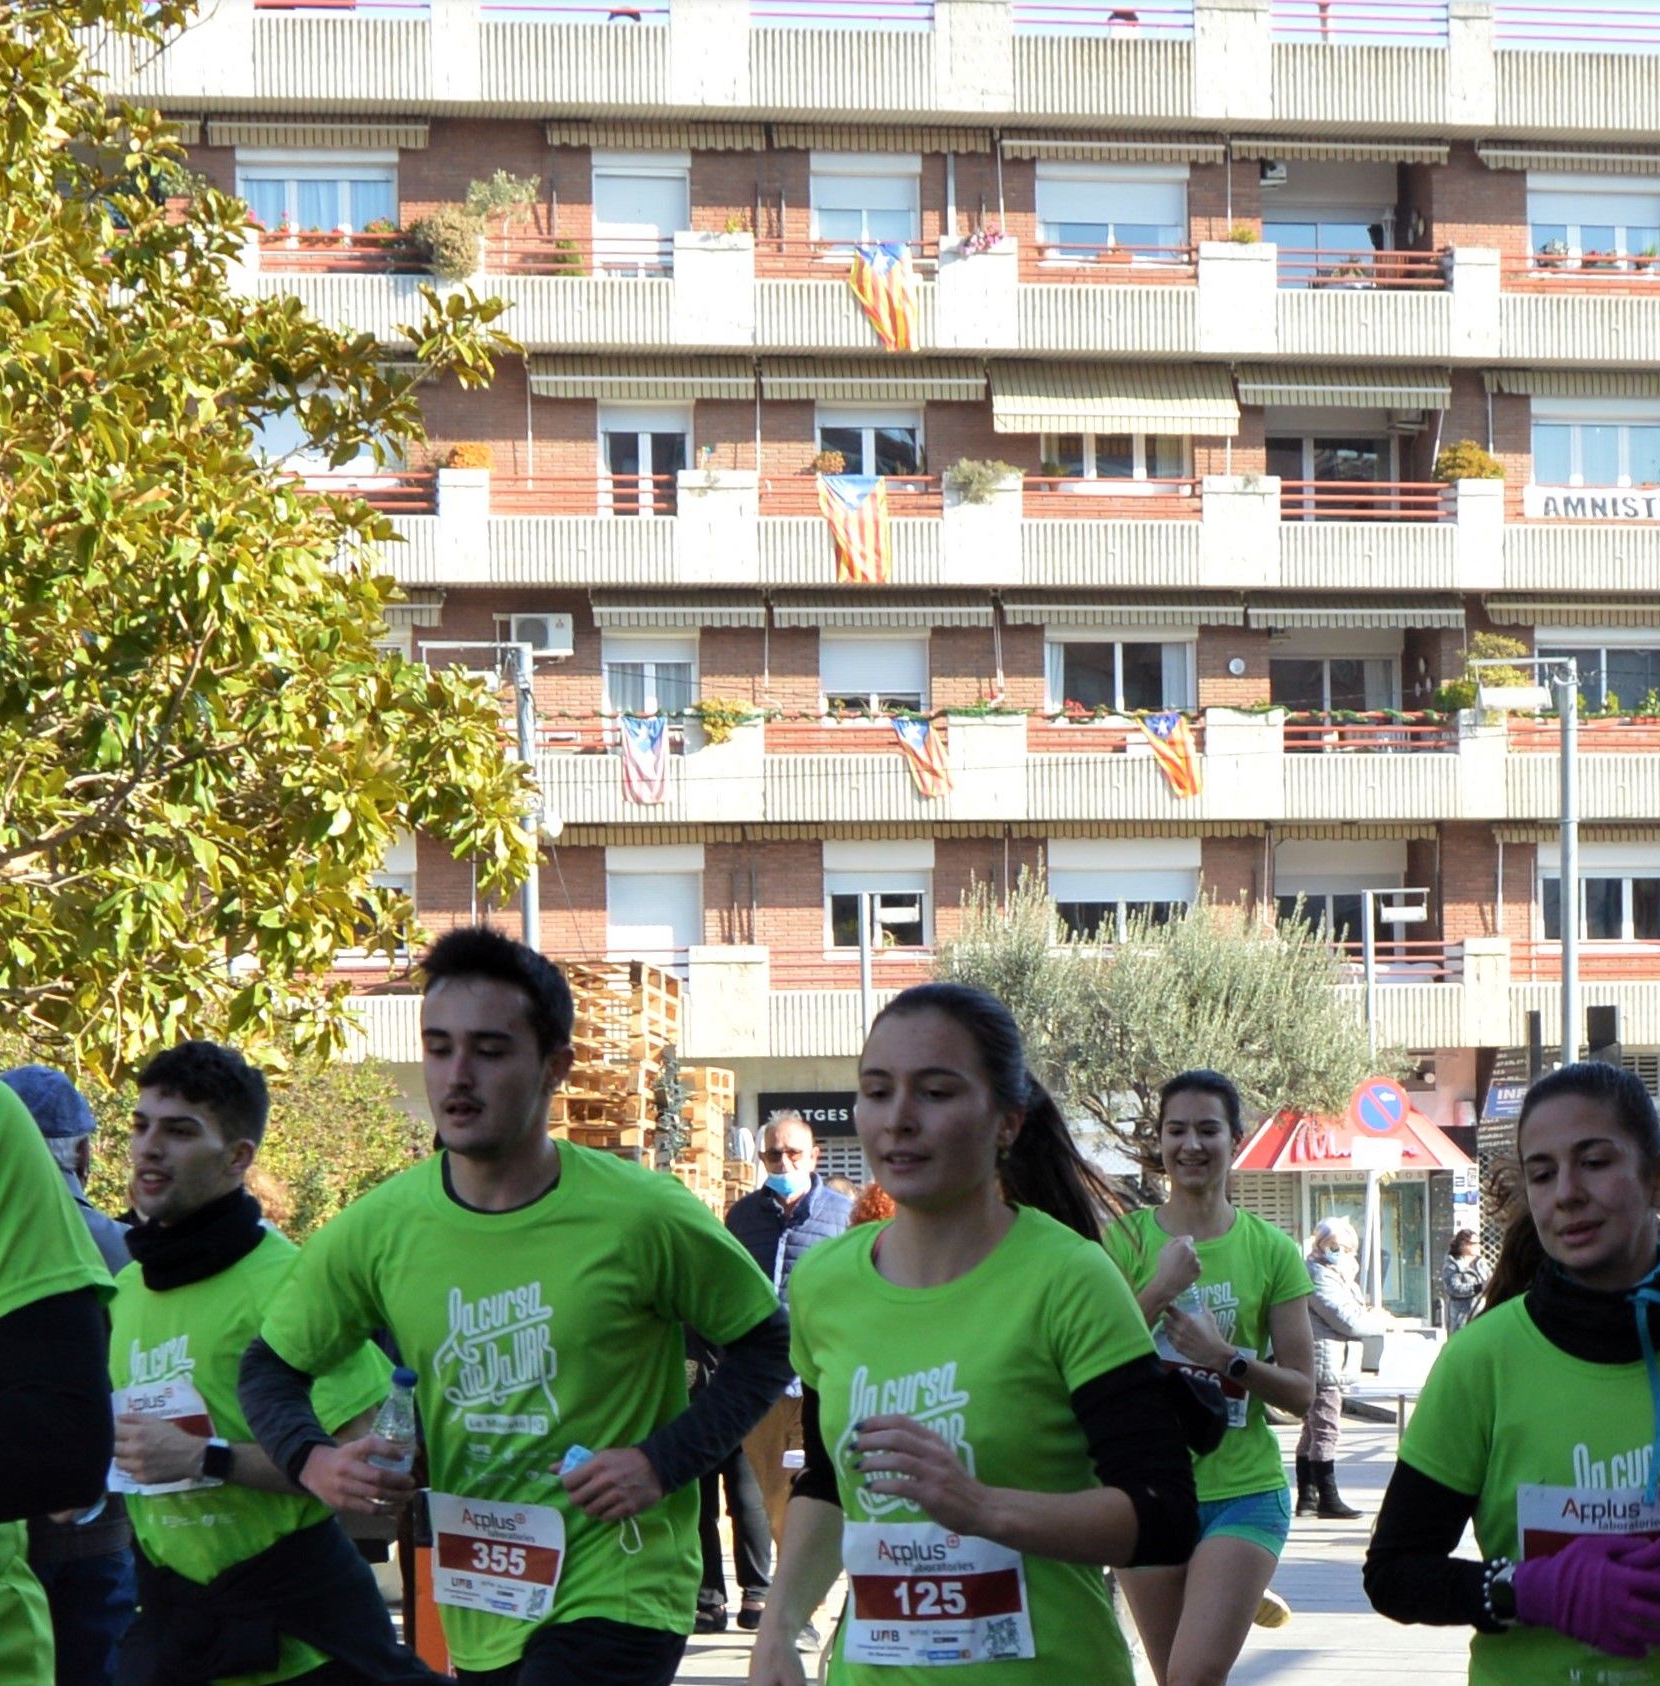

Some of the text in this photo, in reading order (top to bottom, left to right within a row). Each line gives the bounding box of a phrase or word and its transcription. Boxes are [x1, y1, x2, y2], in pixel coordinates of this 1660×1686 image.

[768, 1108, 849, 1121] VATGES
[1309, 1171, 1426, 1182] PELUQOS
[462, 1508, 517, 1532] Applus
[1562, 1498, 1641, 1525] Applus
[472, 1542, 527, 1575] 355
[878, 1540, 946, 1567] Applus
[893, 1580, 967, 1616] 125
